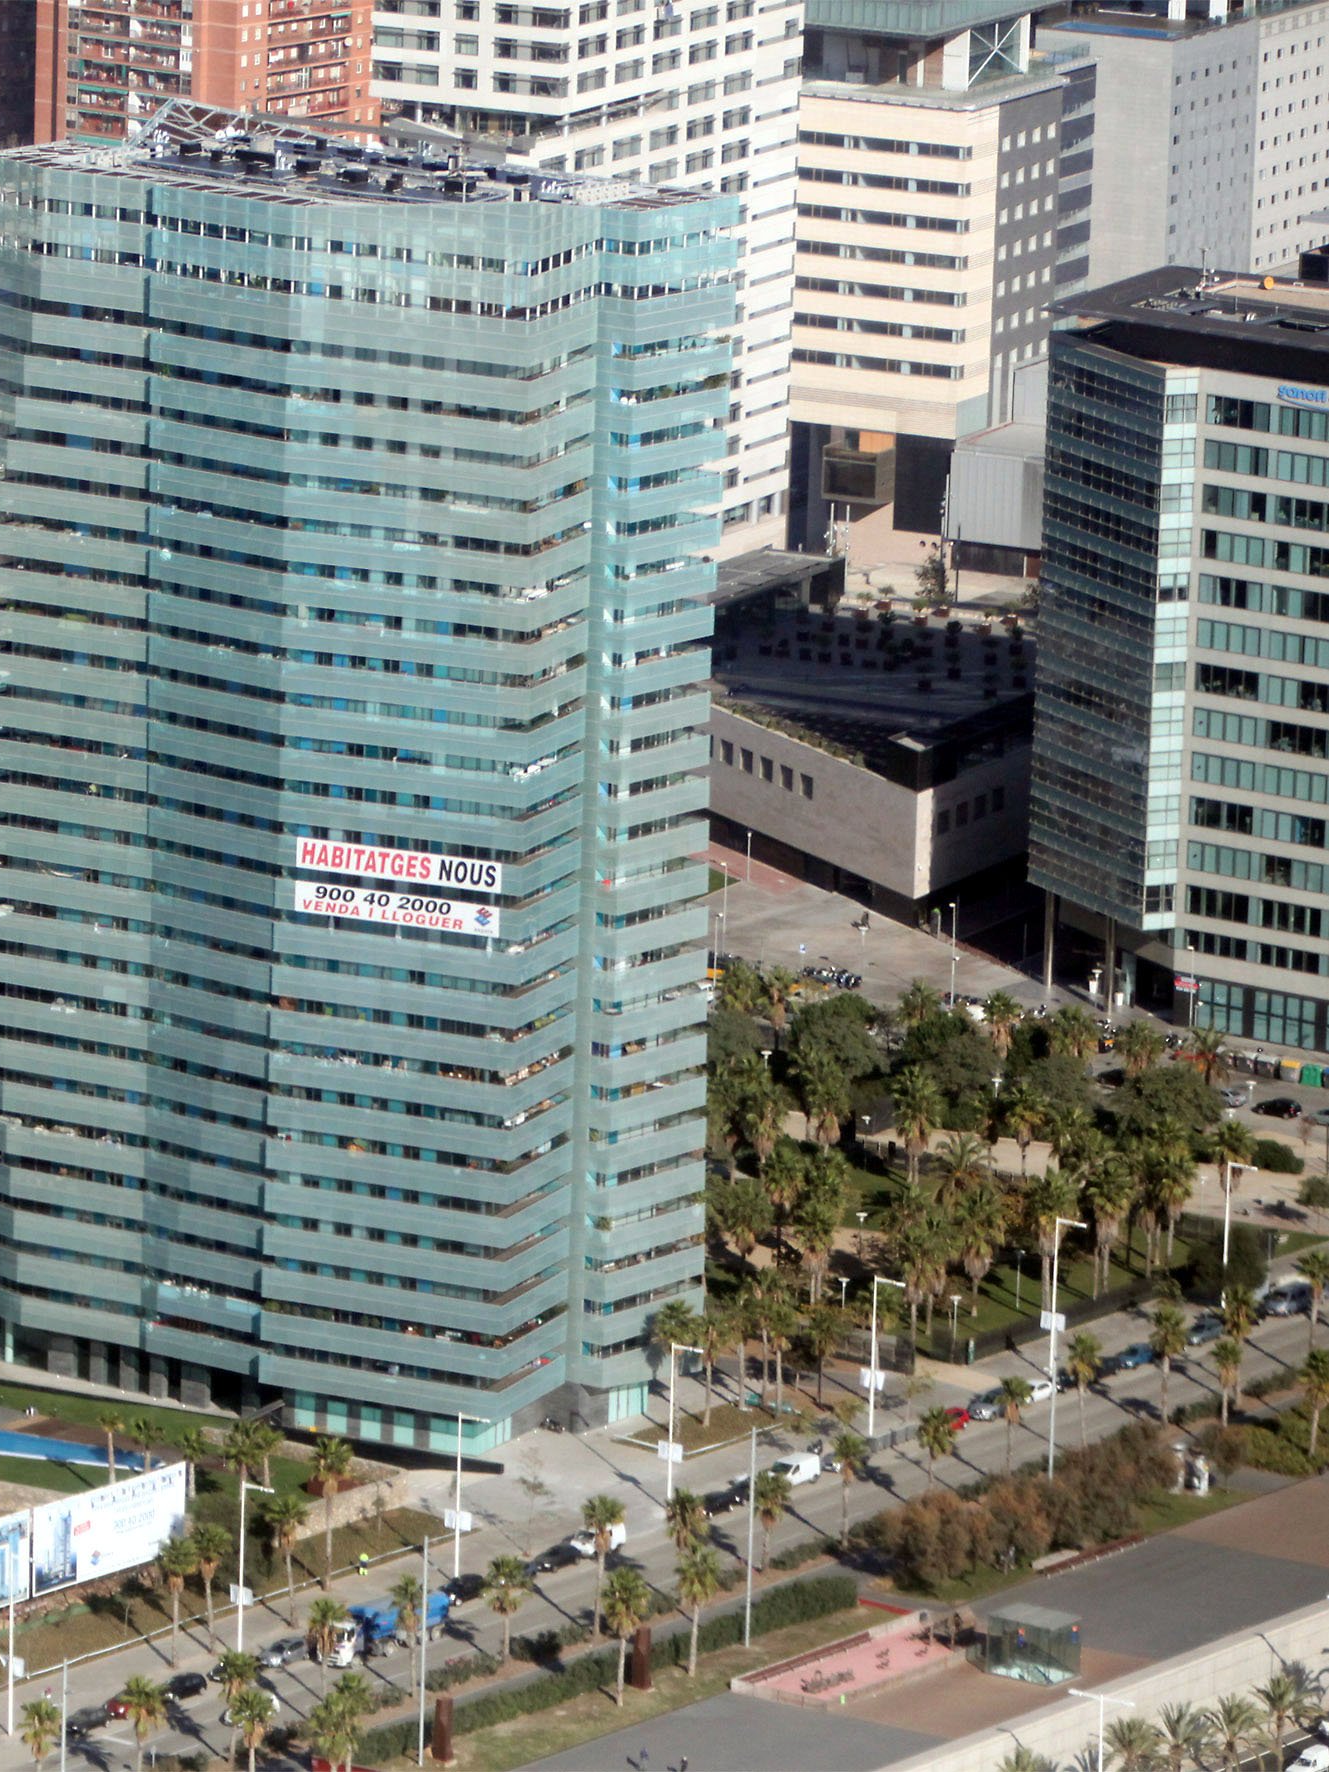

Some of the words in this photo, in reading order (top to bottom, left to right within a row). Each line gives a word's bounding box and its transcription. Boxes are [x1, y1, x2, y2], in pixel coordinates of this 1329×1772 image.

[301, 841, 432, 880] HABITATGES
[438, 858, 497, 888] NOUS
[302, 899, 361, 917] VENDA
[367, 907, 374, 918] I
[381, 909, 464, 930] LLOGUER
[314, 885, 356, 903] 900
[362, 892, 390, 907] 40
[397, 896, 452, 916] 2000
